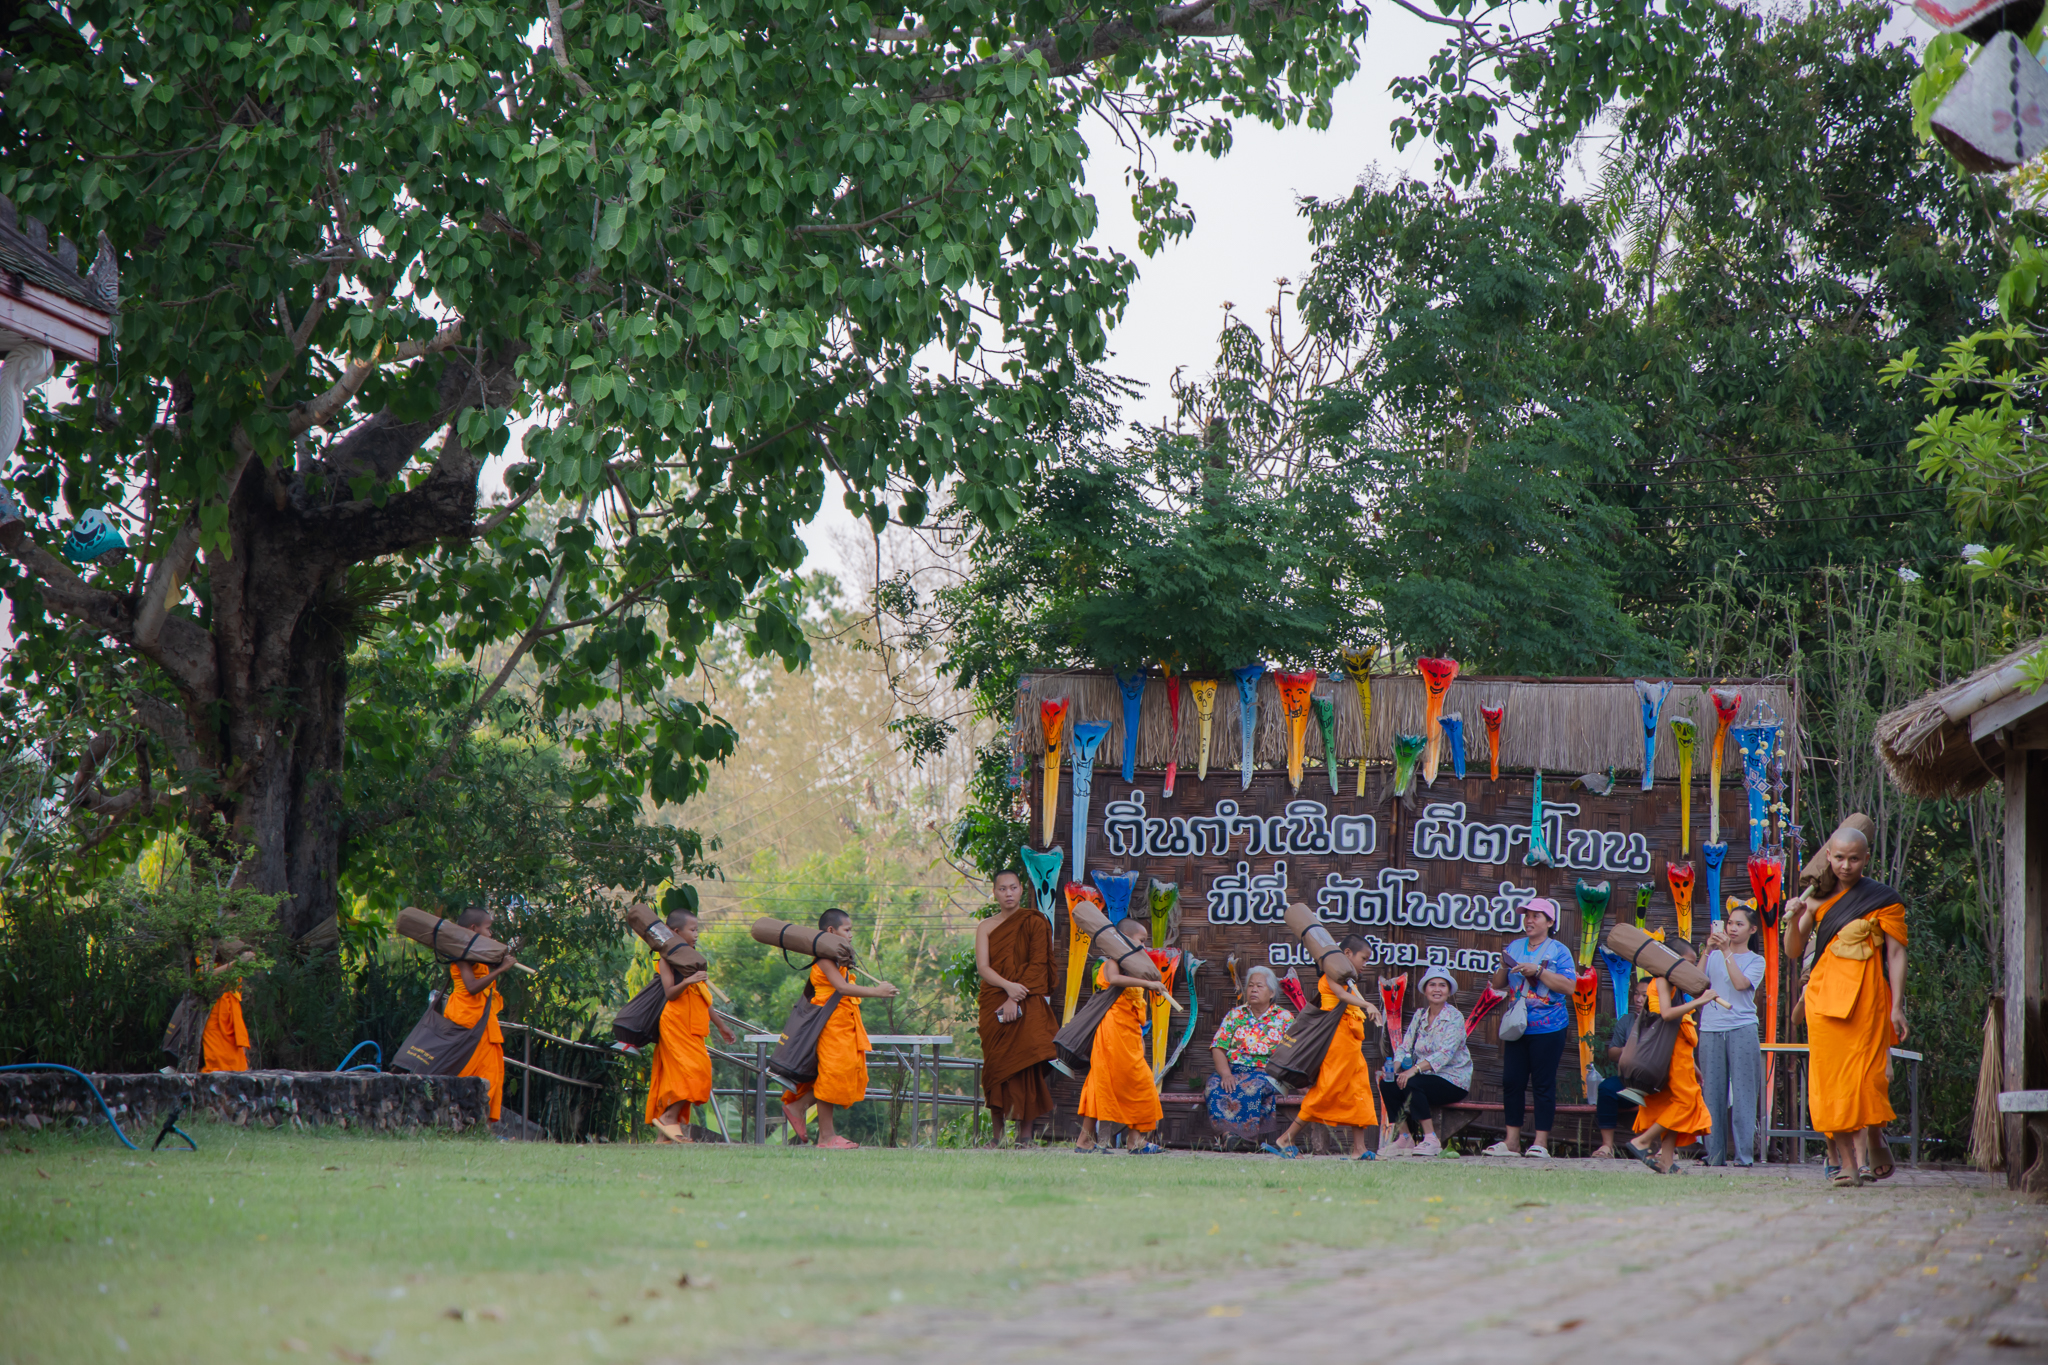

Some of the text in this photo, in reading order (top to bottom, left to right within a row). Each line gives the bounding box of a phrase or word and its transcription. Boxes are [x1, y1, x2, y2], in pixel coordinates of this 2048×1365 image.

[1104, 790, 1377, 857] ถิ่นกำเนิด
[1206, 860, 1561, 934] ที่นี่ วัดโพนชั
